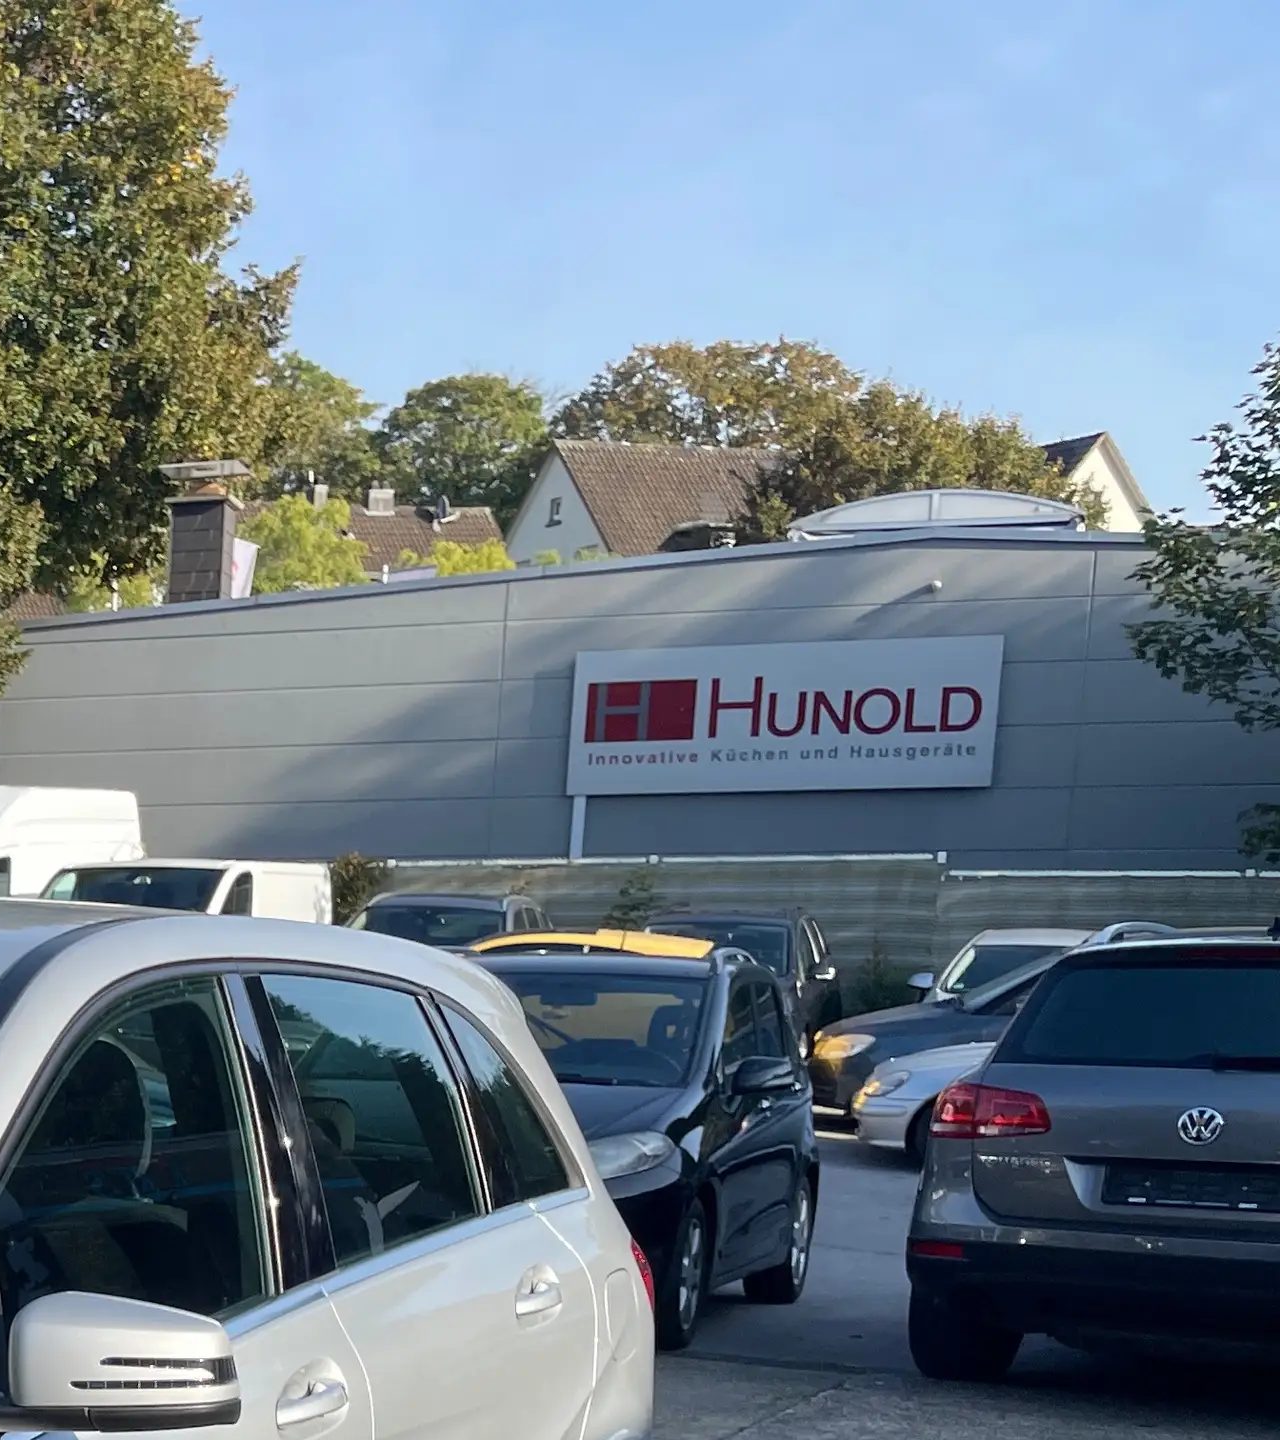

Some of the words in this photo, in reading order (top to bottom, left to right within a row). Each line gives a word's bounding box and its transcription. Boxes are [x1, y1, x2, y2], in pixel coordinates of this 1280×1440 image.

[707, 676, 984, 739] HUNOLD
[587, 749, 700, 767] Innovative
[710, 745, 790, 763] Küchen
[800, 744, 839, 761] und
[850, 742, 978, 762] Hausgeräte
